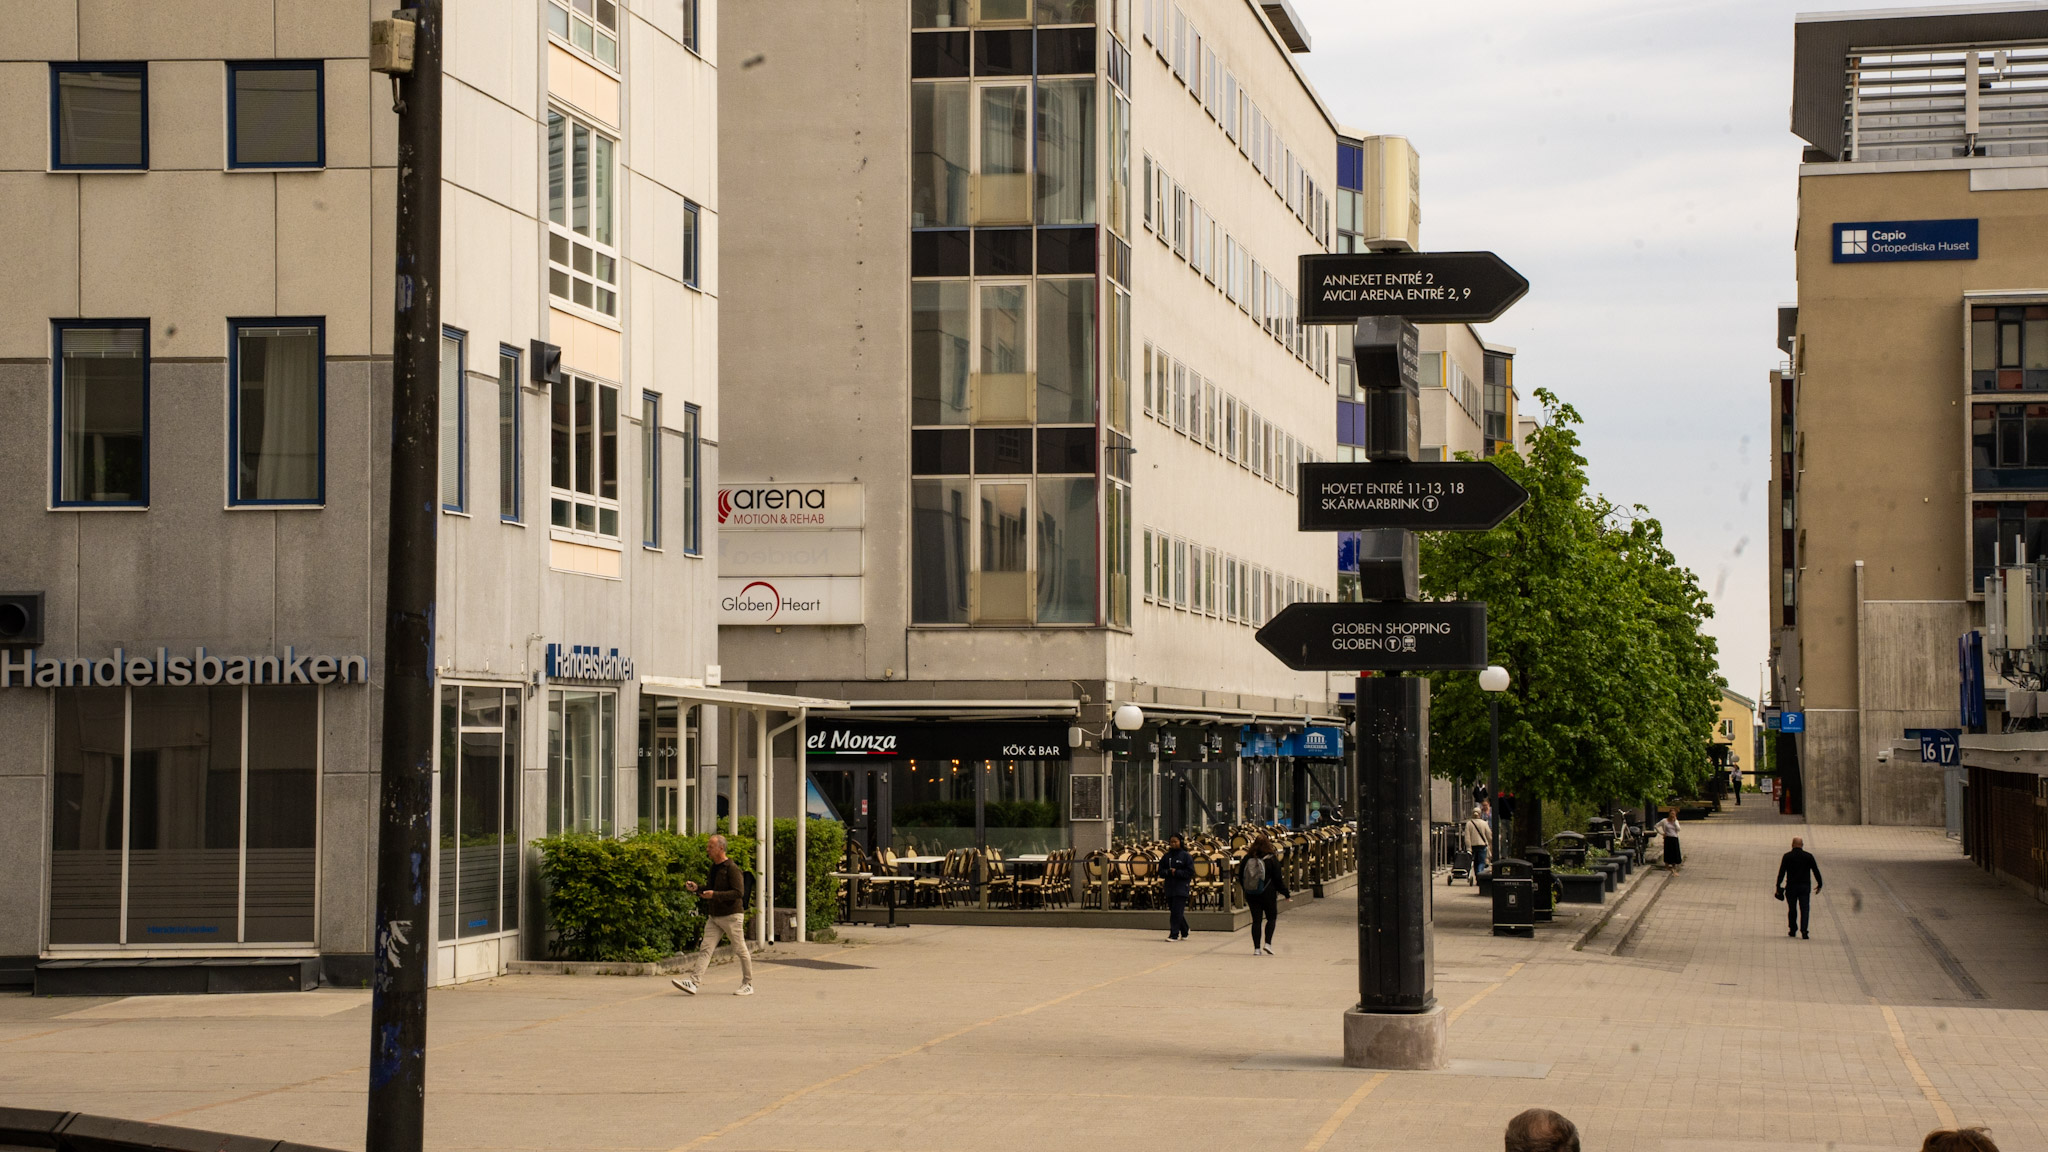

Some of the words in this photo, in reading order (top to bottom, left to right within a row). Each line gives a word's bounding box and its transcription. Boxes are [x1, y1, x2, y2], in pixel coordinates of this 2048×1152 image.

[1871, 230, 1907, 242] Capio
[1871, 242, 1936, 254] Ortopediska
[1938, 241, 1970, 251] Huset
[1322, 273, 1382, 286] ANNEXET
[1385, 270, 1422, 285] ENTRÉ
[1425, 272, 1434, 285] 2
[1322, 289, 1357, 301] AVICII
[1359, 289, 1404, 301] ARENA
[1407, 286, 1445, 300] ENTRÉ
[1447, 288, 1459, 301] 2,
[1462, 287, 1471, 299] 9
[1321, 483, 1363, 494] HOVET
[1366, 480, 1403, 494] ENTRÉ
[1408, 482, 1446, 496] 11-13,
[1450, 482, 1465, 494] 18
[733, 489, 825, 509] arena
[1321, 496, 1420, 510] SKÄRMARBRINK
[733, 514, 778, 524] MOTION
[780, 513, 788, 524] &
[790, 513, 825, 524] REHAB
[721, 597, 773, 612] Globen
[781, 597, 821, 612] Heart
[1331, 622, 1382, 635] GLOBEN
[1385, 622, 1451, 634] SHOPPING
[1331, 638, 1382, 650] GLOBEN
[1, 645, 369, 688] Handelsbanken
[553, 643, 634, 681] Handelsbanken
[807, 730, 827, 749] el
[830, 730, 897, 752] Monza
[1002, 744, 1026, 756] KÖK
[1028, 745, 1036, 756] &
[1038, 745, 1060, 756] BAR
[1922, 743, 1937, 760] 16
[1940, 744, 1955, 764] 17
